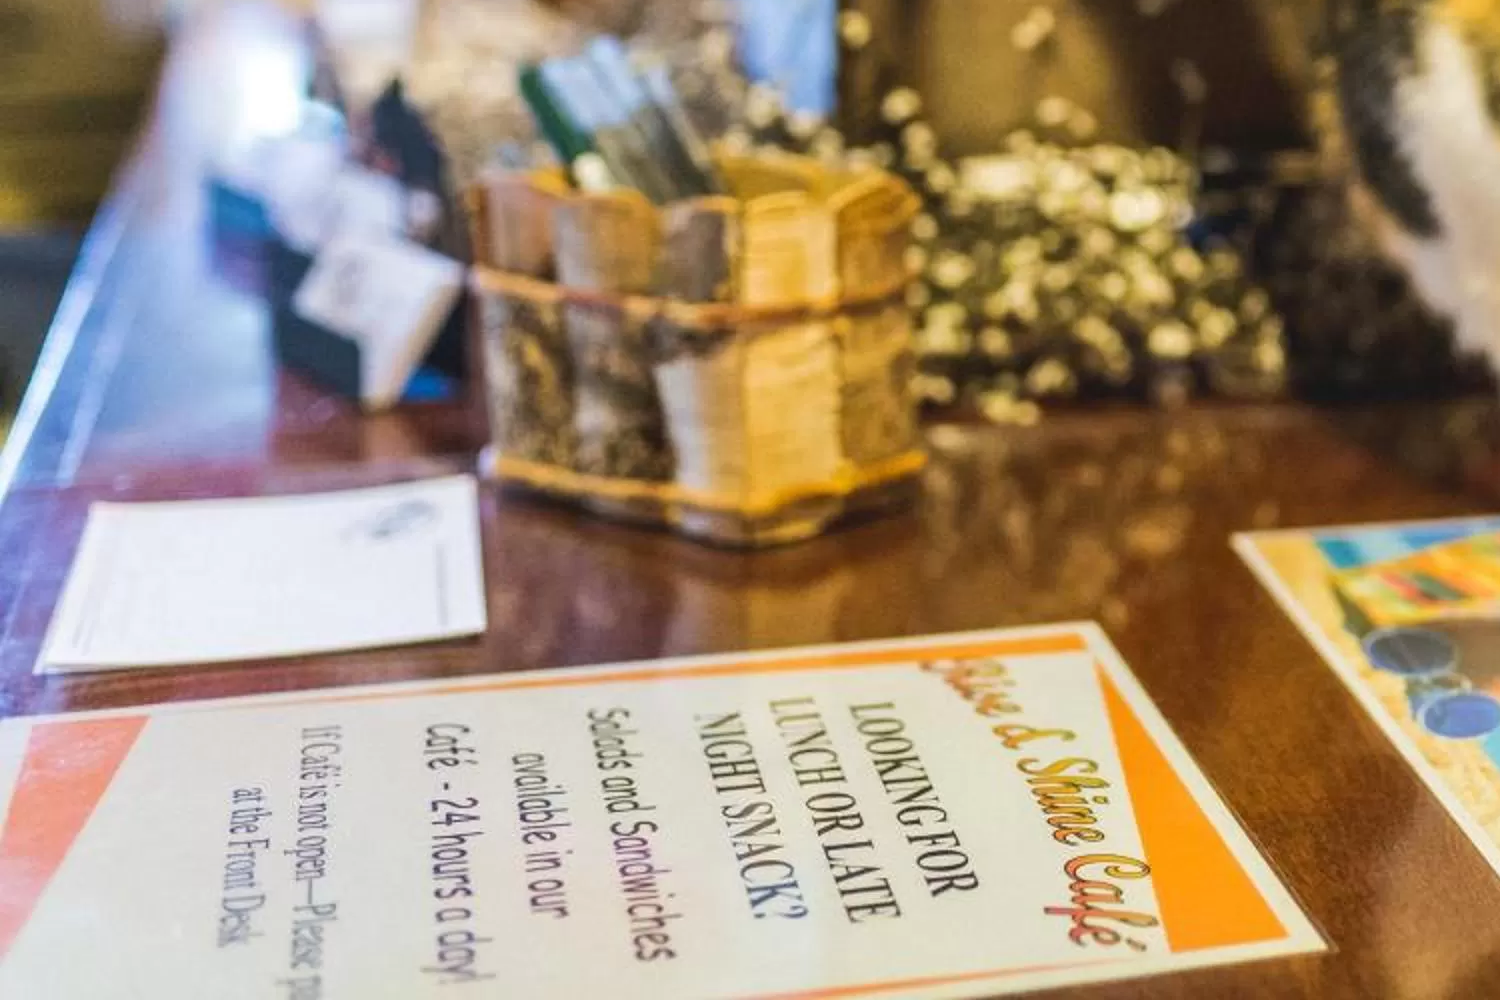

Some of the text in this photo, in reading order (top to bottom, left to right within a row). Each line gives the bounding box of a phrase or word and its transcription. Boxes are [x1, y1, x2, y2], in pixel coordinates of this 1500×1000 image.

[300, 743, 342, 781] Café
[301, 725, 342, 741] If
[423, 722, 479, 771] Café
[992, 724, 1076, 750] &
[298, 803, 330, 832] not
[300, 783, 341, 800] is
[431, 797, 481, 826] 24
[694, 711, 809, 920] NIGHT SNACK?
[769, 697, 902, 924] LUNCH OR LATE
[848, 701, 979, 897] LOOKING FOR
[1016, 757, 1109, 846] Shine
[432, 830, 485, 900] hours
[512, 752, 573, 919] available in our
[588, 707, 684, 963] Salads and Sandwiches
[216, 787, 272, 949] at the Front Desk
[435, 906, 472, 923] a
[1043, 853, 1158, 952] Café
[420, 930, 497, 985] day!
